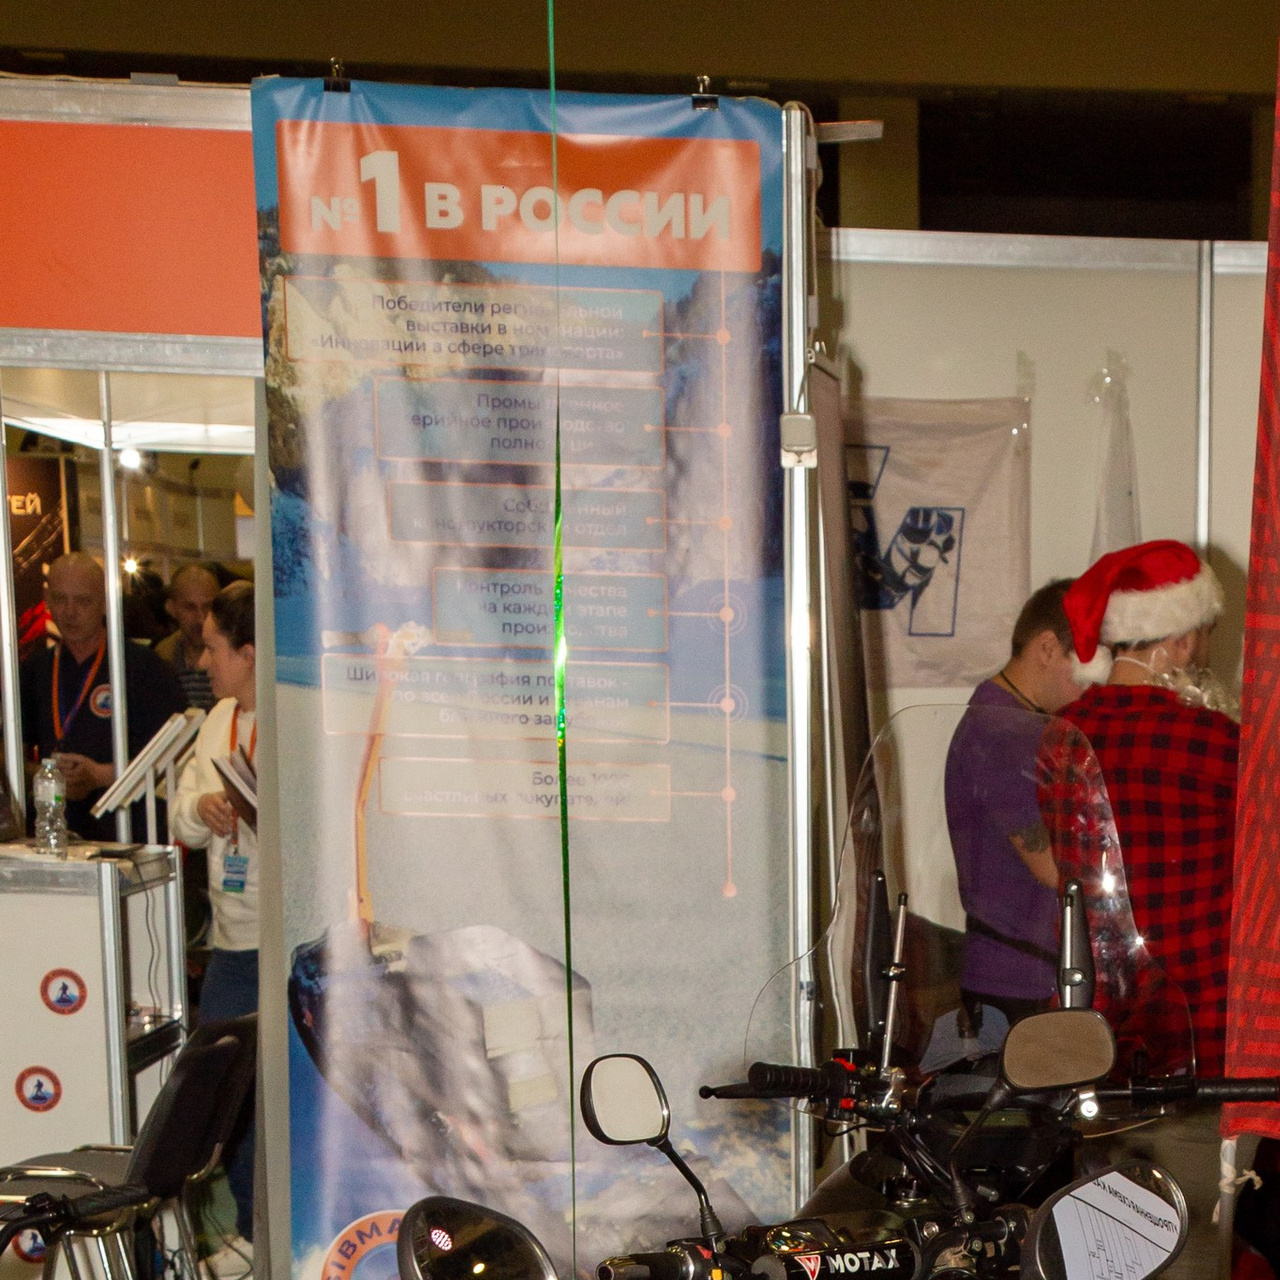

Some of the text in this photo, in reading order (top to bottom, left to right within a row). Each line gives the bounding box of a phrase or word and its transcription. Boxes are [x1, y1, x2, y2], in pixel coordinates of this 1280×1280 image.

[425, 182, 464, 230] В
[482, 184, 732, 240] РОССИИ
[373, 296, 623, 319] Победители регильной
[406, 320, 491, 335] выставки
[498, 323, 508, 335] в
[447, 339, 505, 357] сфере
[410, 412, 491, 430] ерийное
[7, 492, 42, 516] ЕЙ
[456, 580, 543, 599] онтроль
[347, 667, 431, 683] Шиокая
[536, 674, 617, 690] потавок
[532, 771, 587, 787] Боее
[826, 1248, 900, 1274] MOTAX
